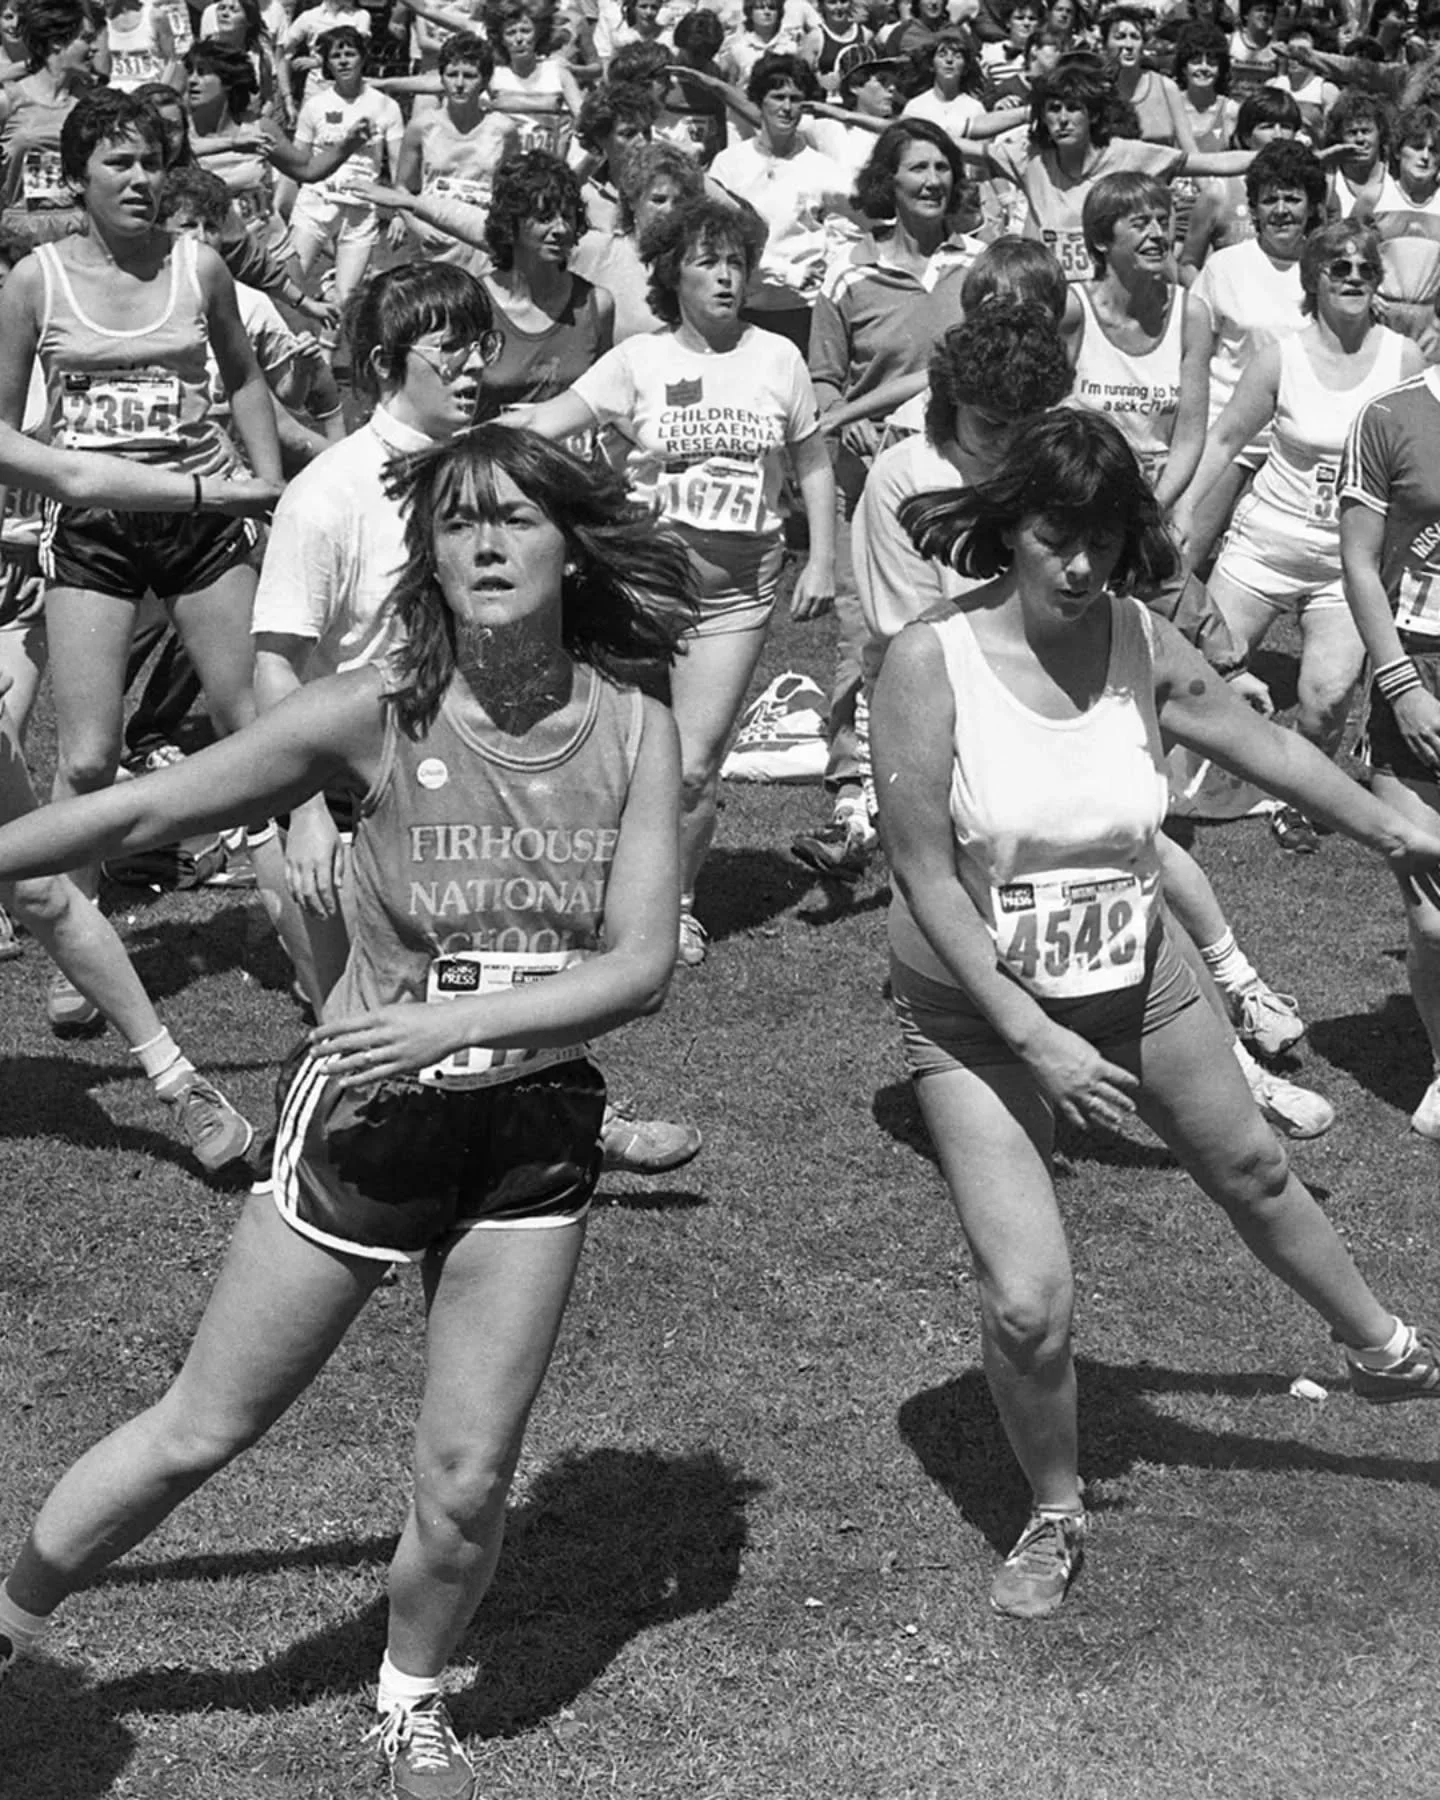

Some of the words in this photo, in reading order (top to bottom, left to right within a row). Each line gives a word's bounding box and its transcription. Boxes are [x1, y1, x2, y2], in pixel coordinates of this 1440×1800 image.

[1080, 379, 1101, 395] I'm
[1104, 383, 1149, 401] running
[1153, 386, 1166, 399] to
[67, 391, 174, 438] 2364
[1114, 399, 1137, 414] sick
[657, 421, 777, 442] LEUKAEMIA
[665, 437, 771, 457] RESEARCH
[666, 478, 756, 525] 1675
[409, 824, 619, 863] FIRHOUSE
[441, 972, 477, 985] PRESS
